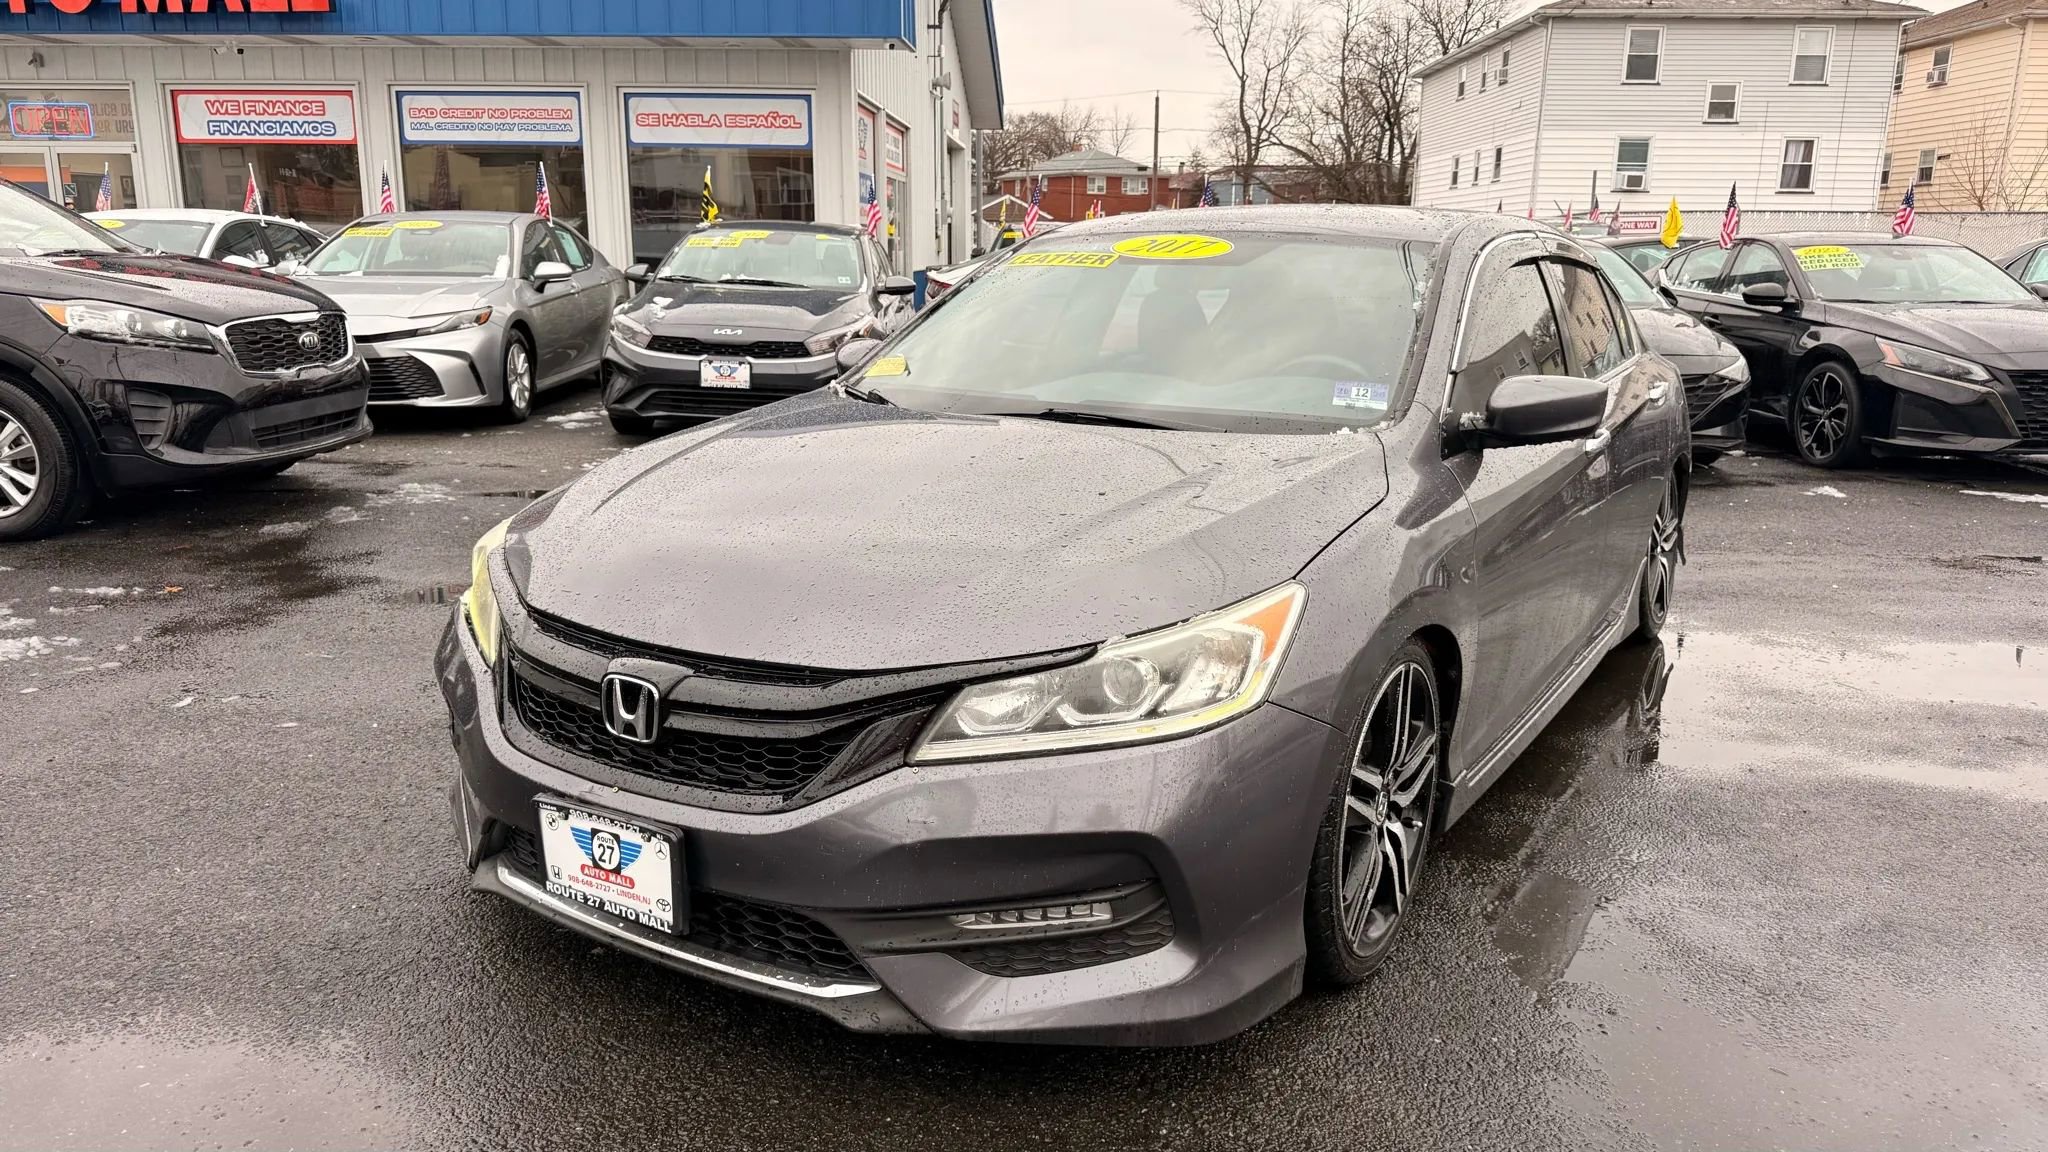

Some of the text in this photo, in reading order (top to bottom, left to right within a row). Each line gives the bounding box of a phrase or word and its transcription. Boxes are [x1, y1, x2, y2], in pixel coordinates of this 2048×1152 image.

[205, 100, 325, 116] WE FINANCE
[409, 108, 572, 119] BAD CREDIT NO PROBLEM
[12, 105, 90, 136] OPEN
[410, 122, 573, 132] MAL CREDITO NO HAY PROBLEMA
[636, 110, 802, 129] SE HABLA ESPAÑOL
[207, 120, 337, 137] FINANCIAMOS
[1619, 221, 1655, 229] ONE WAY
[1124, 239, 1219, 254] 2017
[1011, 252, 1112, 266] LEATHER
[1354, 388, 1369, 398] 12
[539, 802, 557, 811] Linden
[596, 835, 615, 846] ROUTE
[597, 843, 615, 866] 27
[567, 874, 611, 893] 908-648-2727
[583, 866, 632, 887] AUTO MALL
[545, 880, 672, 934] ROUTE 27 AUTO MALL
